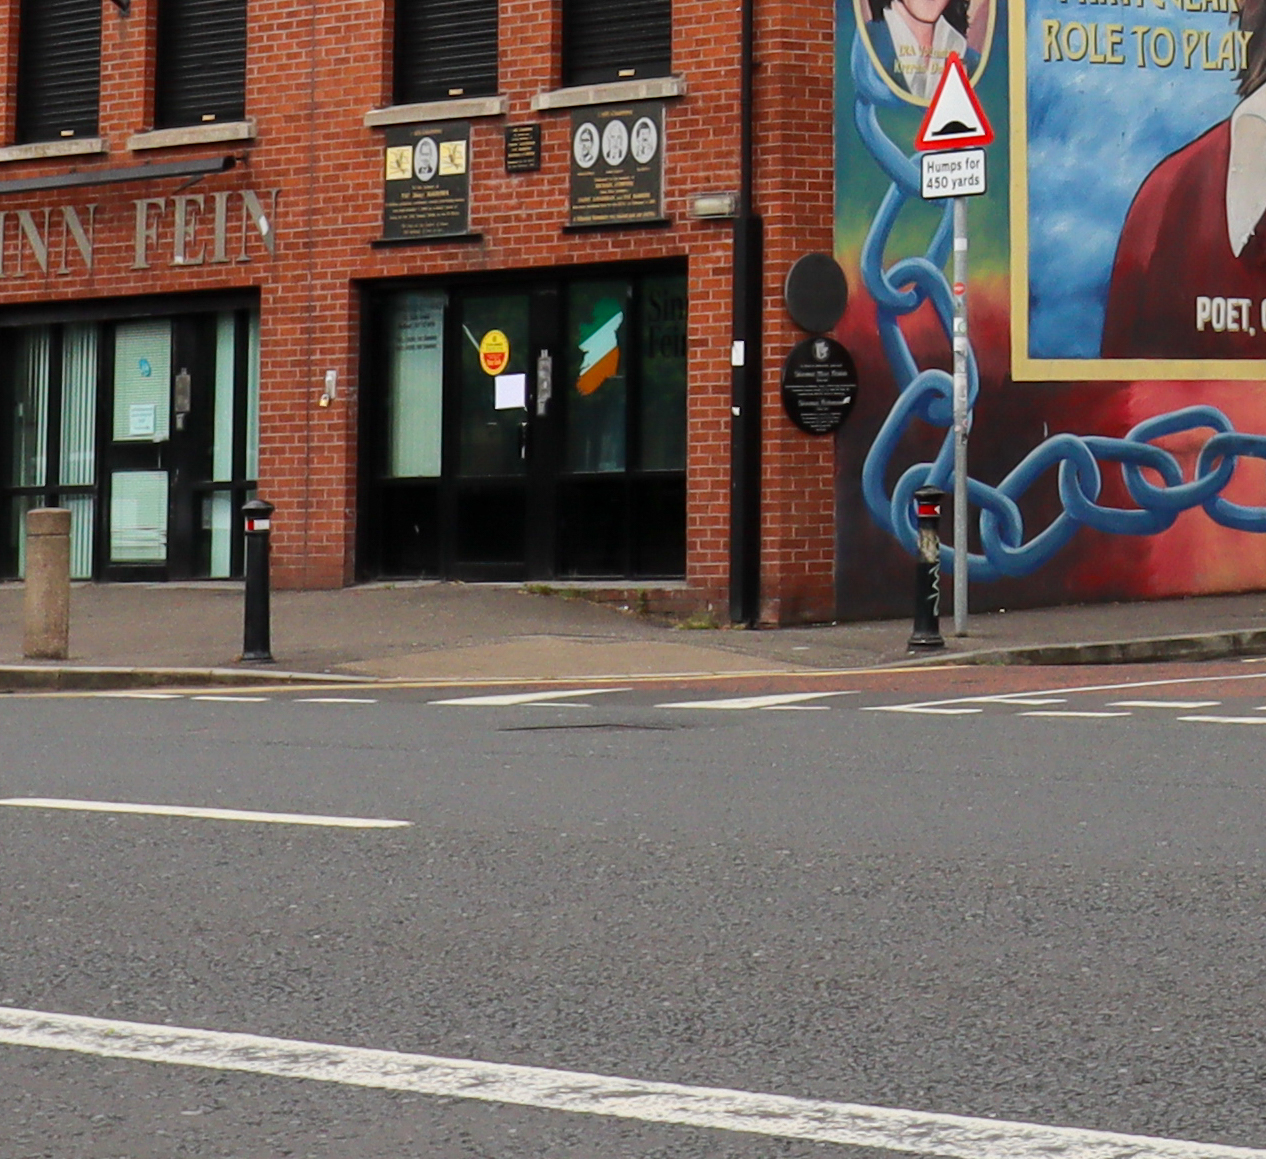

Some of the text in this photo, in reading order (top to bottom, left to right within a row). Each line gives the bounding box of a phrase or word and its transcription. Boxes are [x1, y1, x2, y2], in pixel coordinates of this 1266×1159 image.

[1042, 19, 1254, 72] ROLE TO PLAY
[926, 157, 981, 174] Humps for
[926, 174, 979, 190] 450 yards
[1196, 296, 1256, 337] POET,
